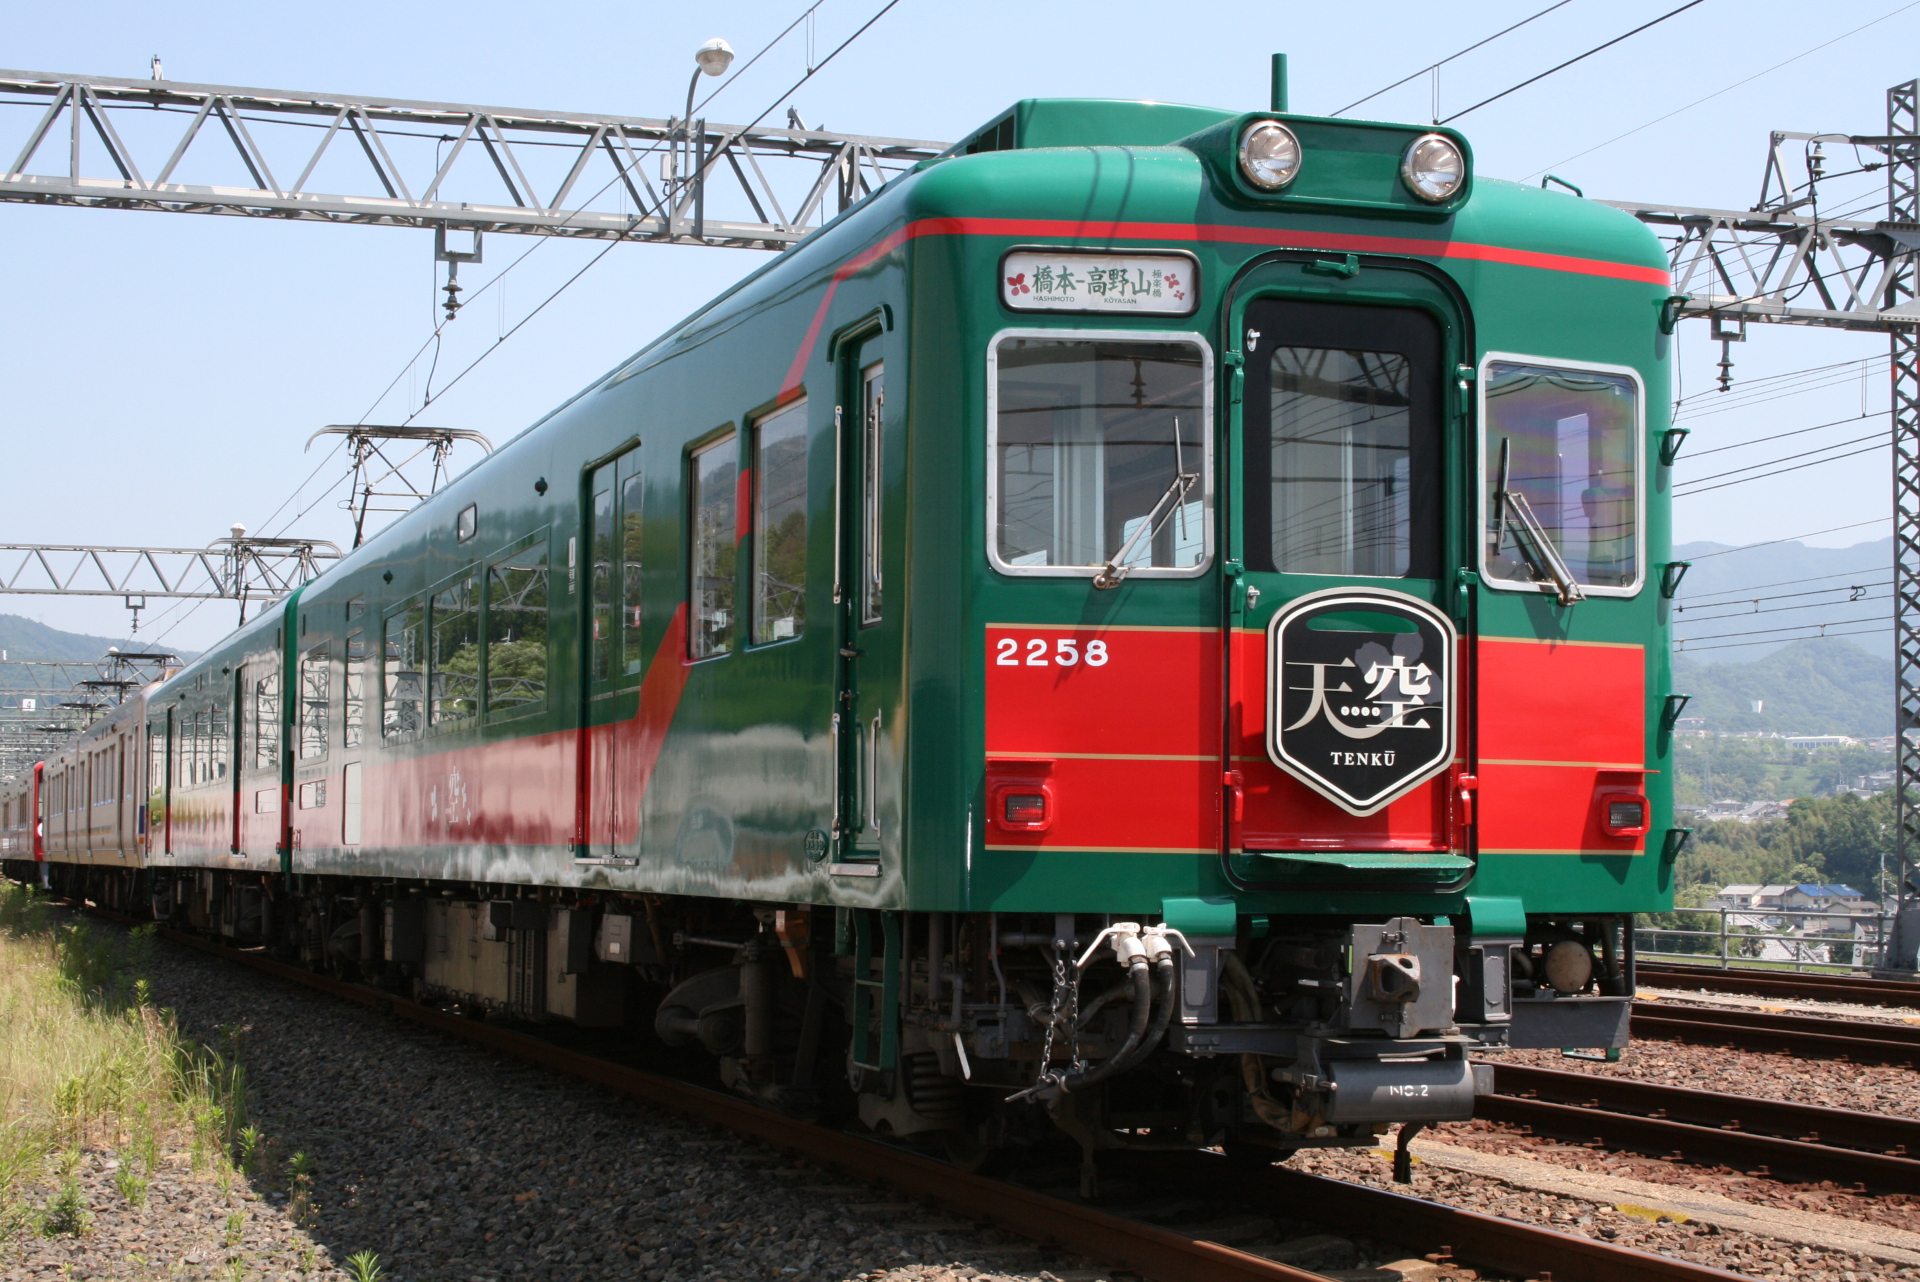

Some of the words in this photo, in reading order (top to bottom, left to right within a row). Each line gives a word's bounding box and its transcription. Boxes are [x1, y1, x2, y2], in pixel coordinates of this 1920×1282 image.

[1033, 295, 1075, 303] HASHIMOTO
[996, 638, 1109, 667] 2258
[1284, 655, 1443, 739] 天空
[1331, 751, 1396, 767] TENKŪ
